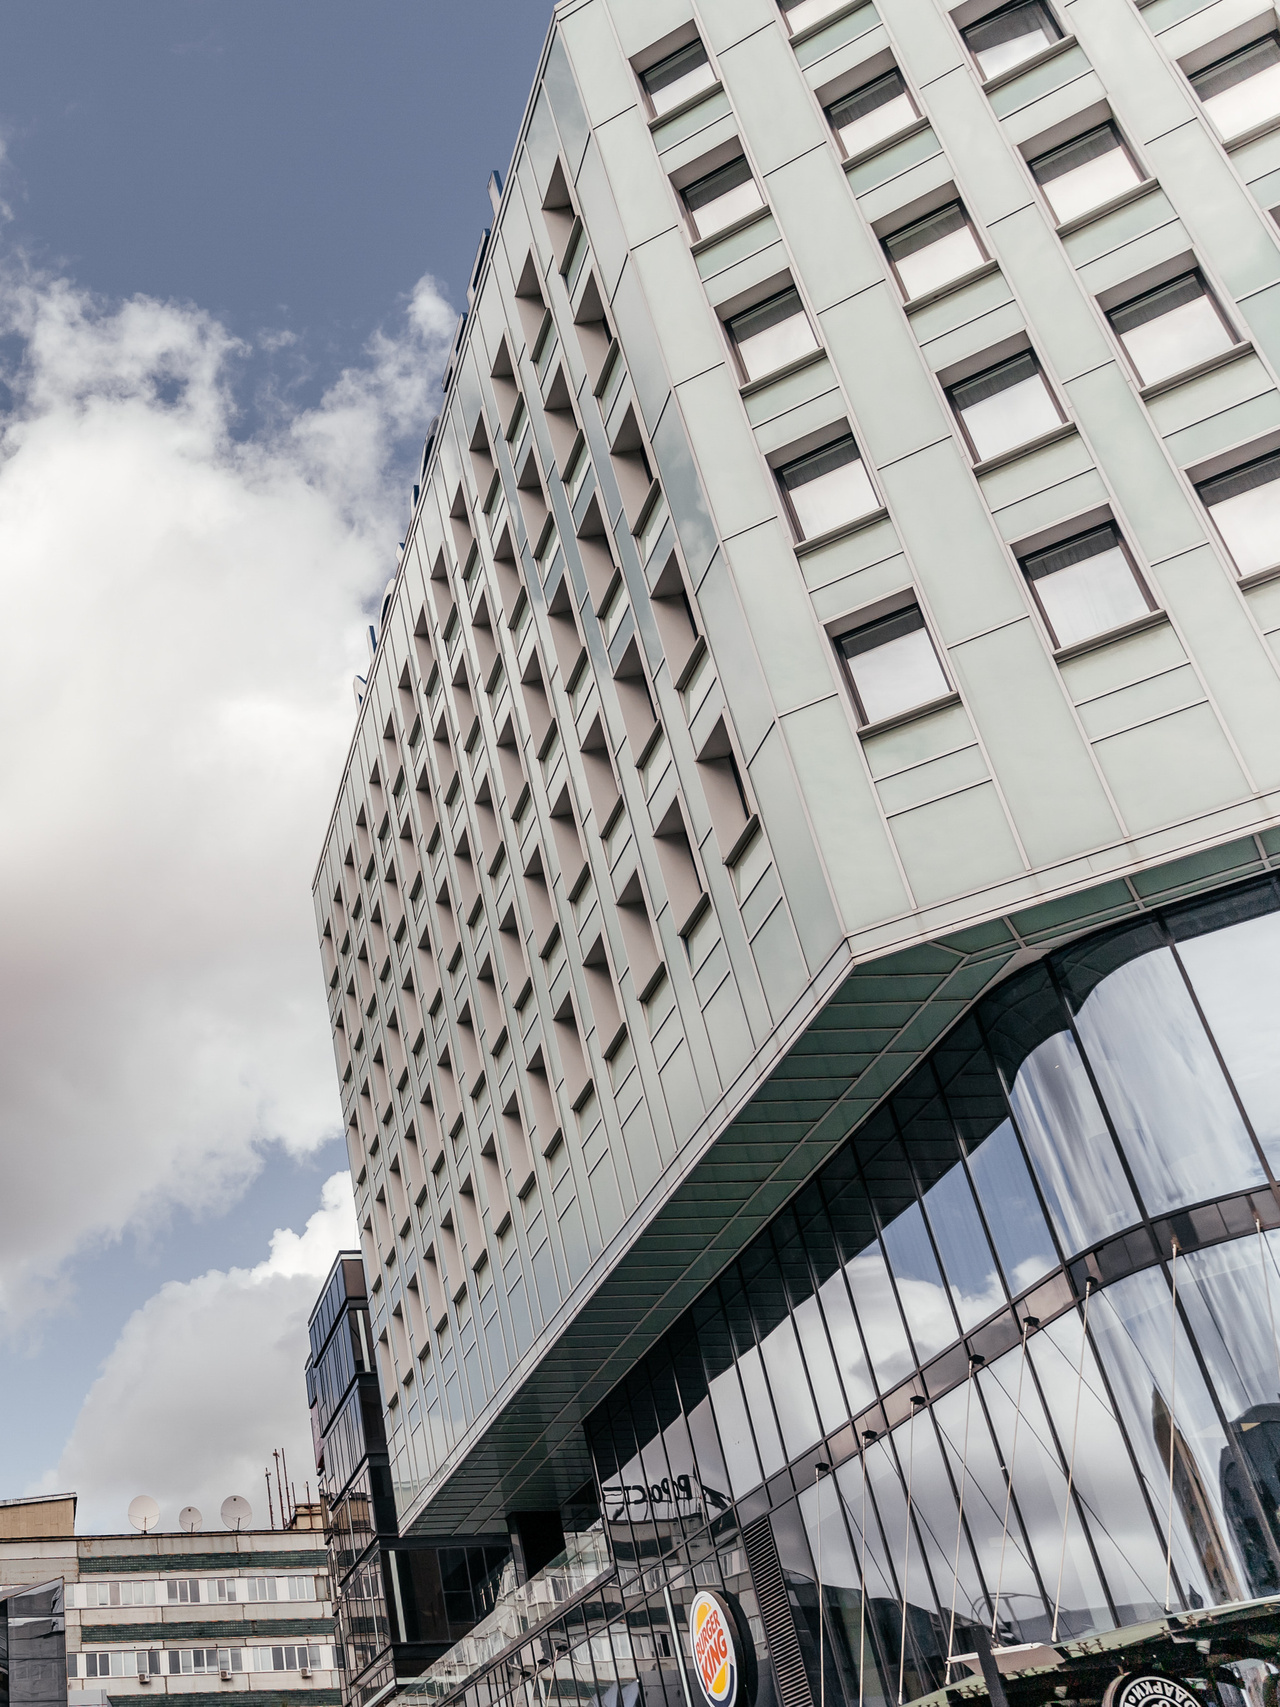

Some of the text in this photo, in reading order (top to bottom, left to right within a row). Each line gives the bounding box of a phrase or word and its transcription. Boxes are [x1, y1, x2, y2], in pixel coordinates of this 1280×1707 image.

[695, 1609, 721, 1665] BURGER
[701, 1628, 728, 1695] KING
[1131, 1681, 1194, 1707] ОДАРКИ
